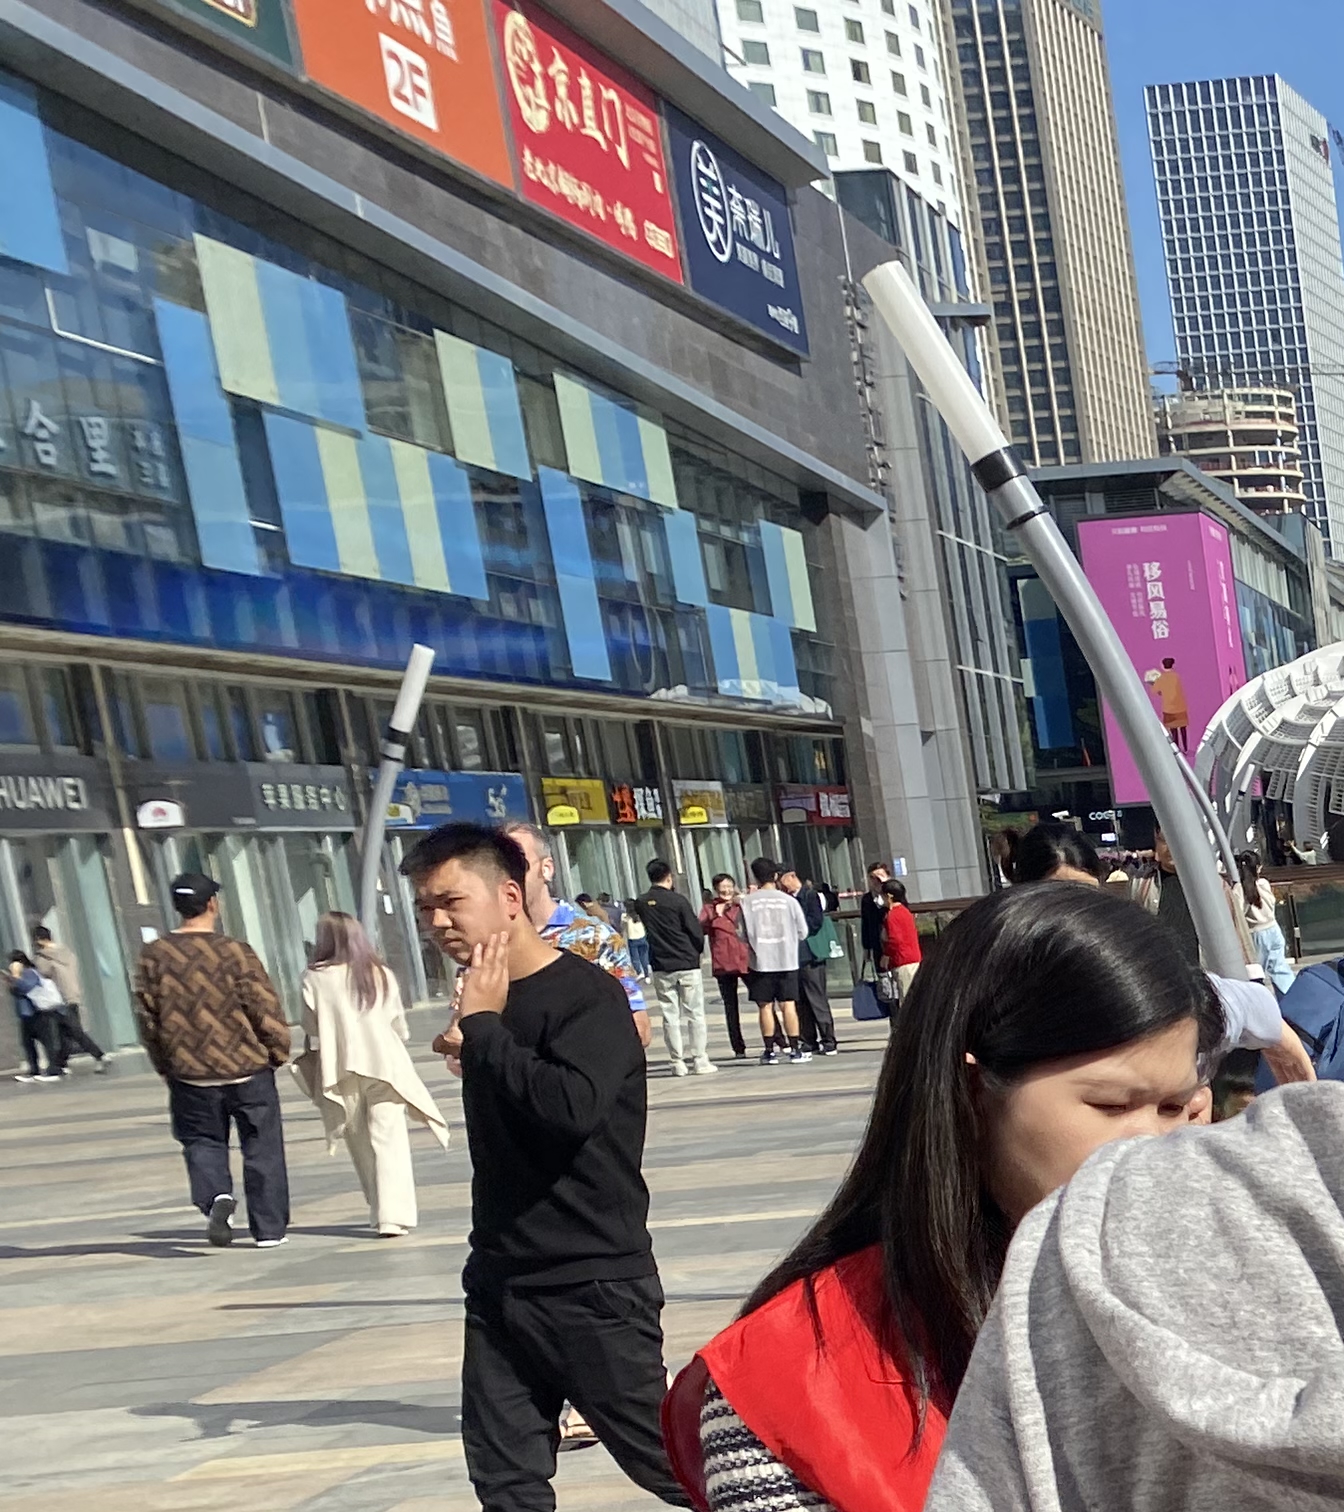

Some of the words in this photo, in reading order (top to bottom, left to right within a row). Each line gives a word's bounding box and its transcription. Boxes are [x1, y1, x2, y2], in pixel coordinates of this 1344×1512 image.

[386, 49, 428, 111] 2F
[0, 399, 117, 476] 合里
[1143, 562, 1170, 640] 移风易俗
